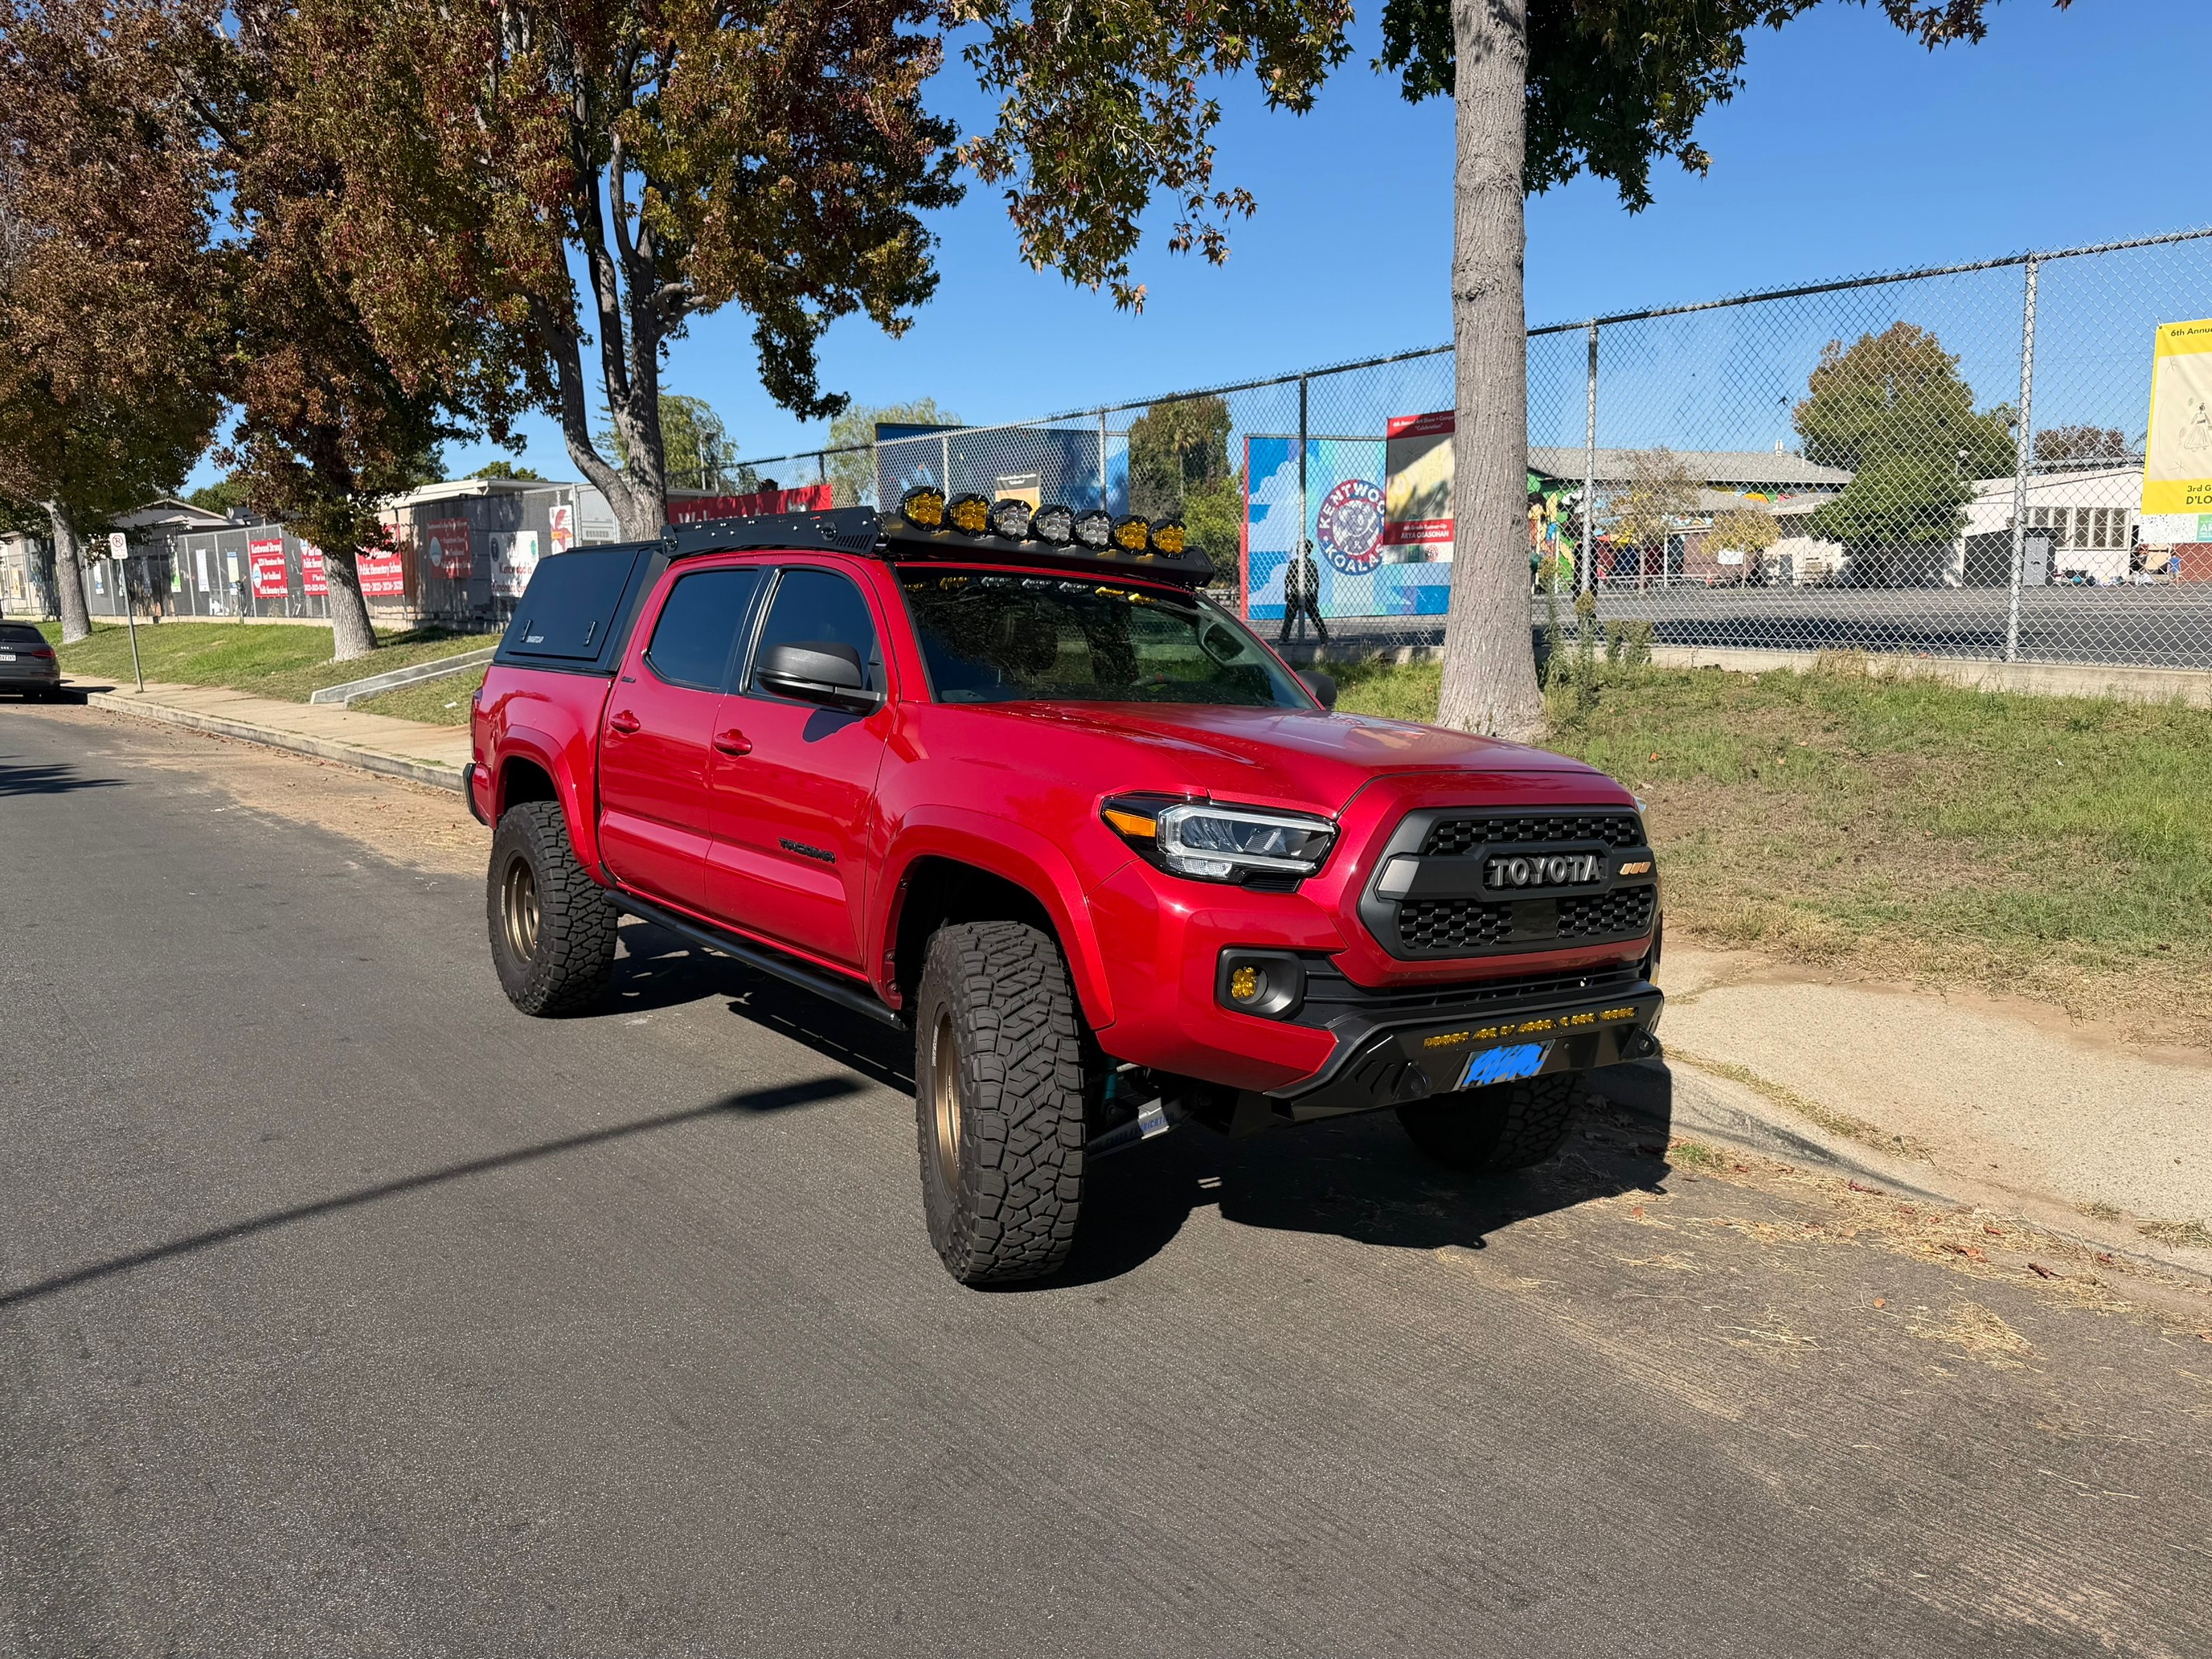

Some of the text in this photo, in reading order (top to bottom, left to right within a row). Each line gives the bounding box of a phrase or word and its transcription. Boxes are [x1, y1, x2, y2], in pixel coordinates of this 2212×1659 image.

[2170, 329, 2185, 337] 6th
[2187, 484, 2203, 493] 3rd
[1318, 482, 1385, 530] KENTWOO
[527, 563, 532, 574] is
[1488, 854, 1601, 887] TOYOTA
